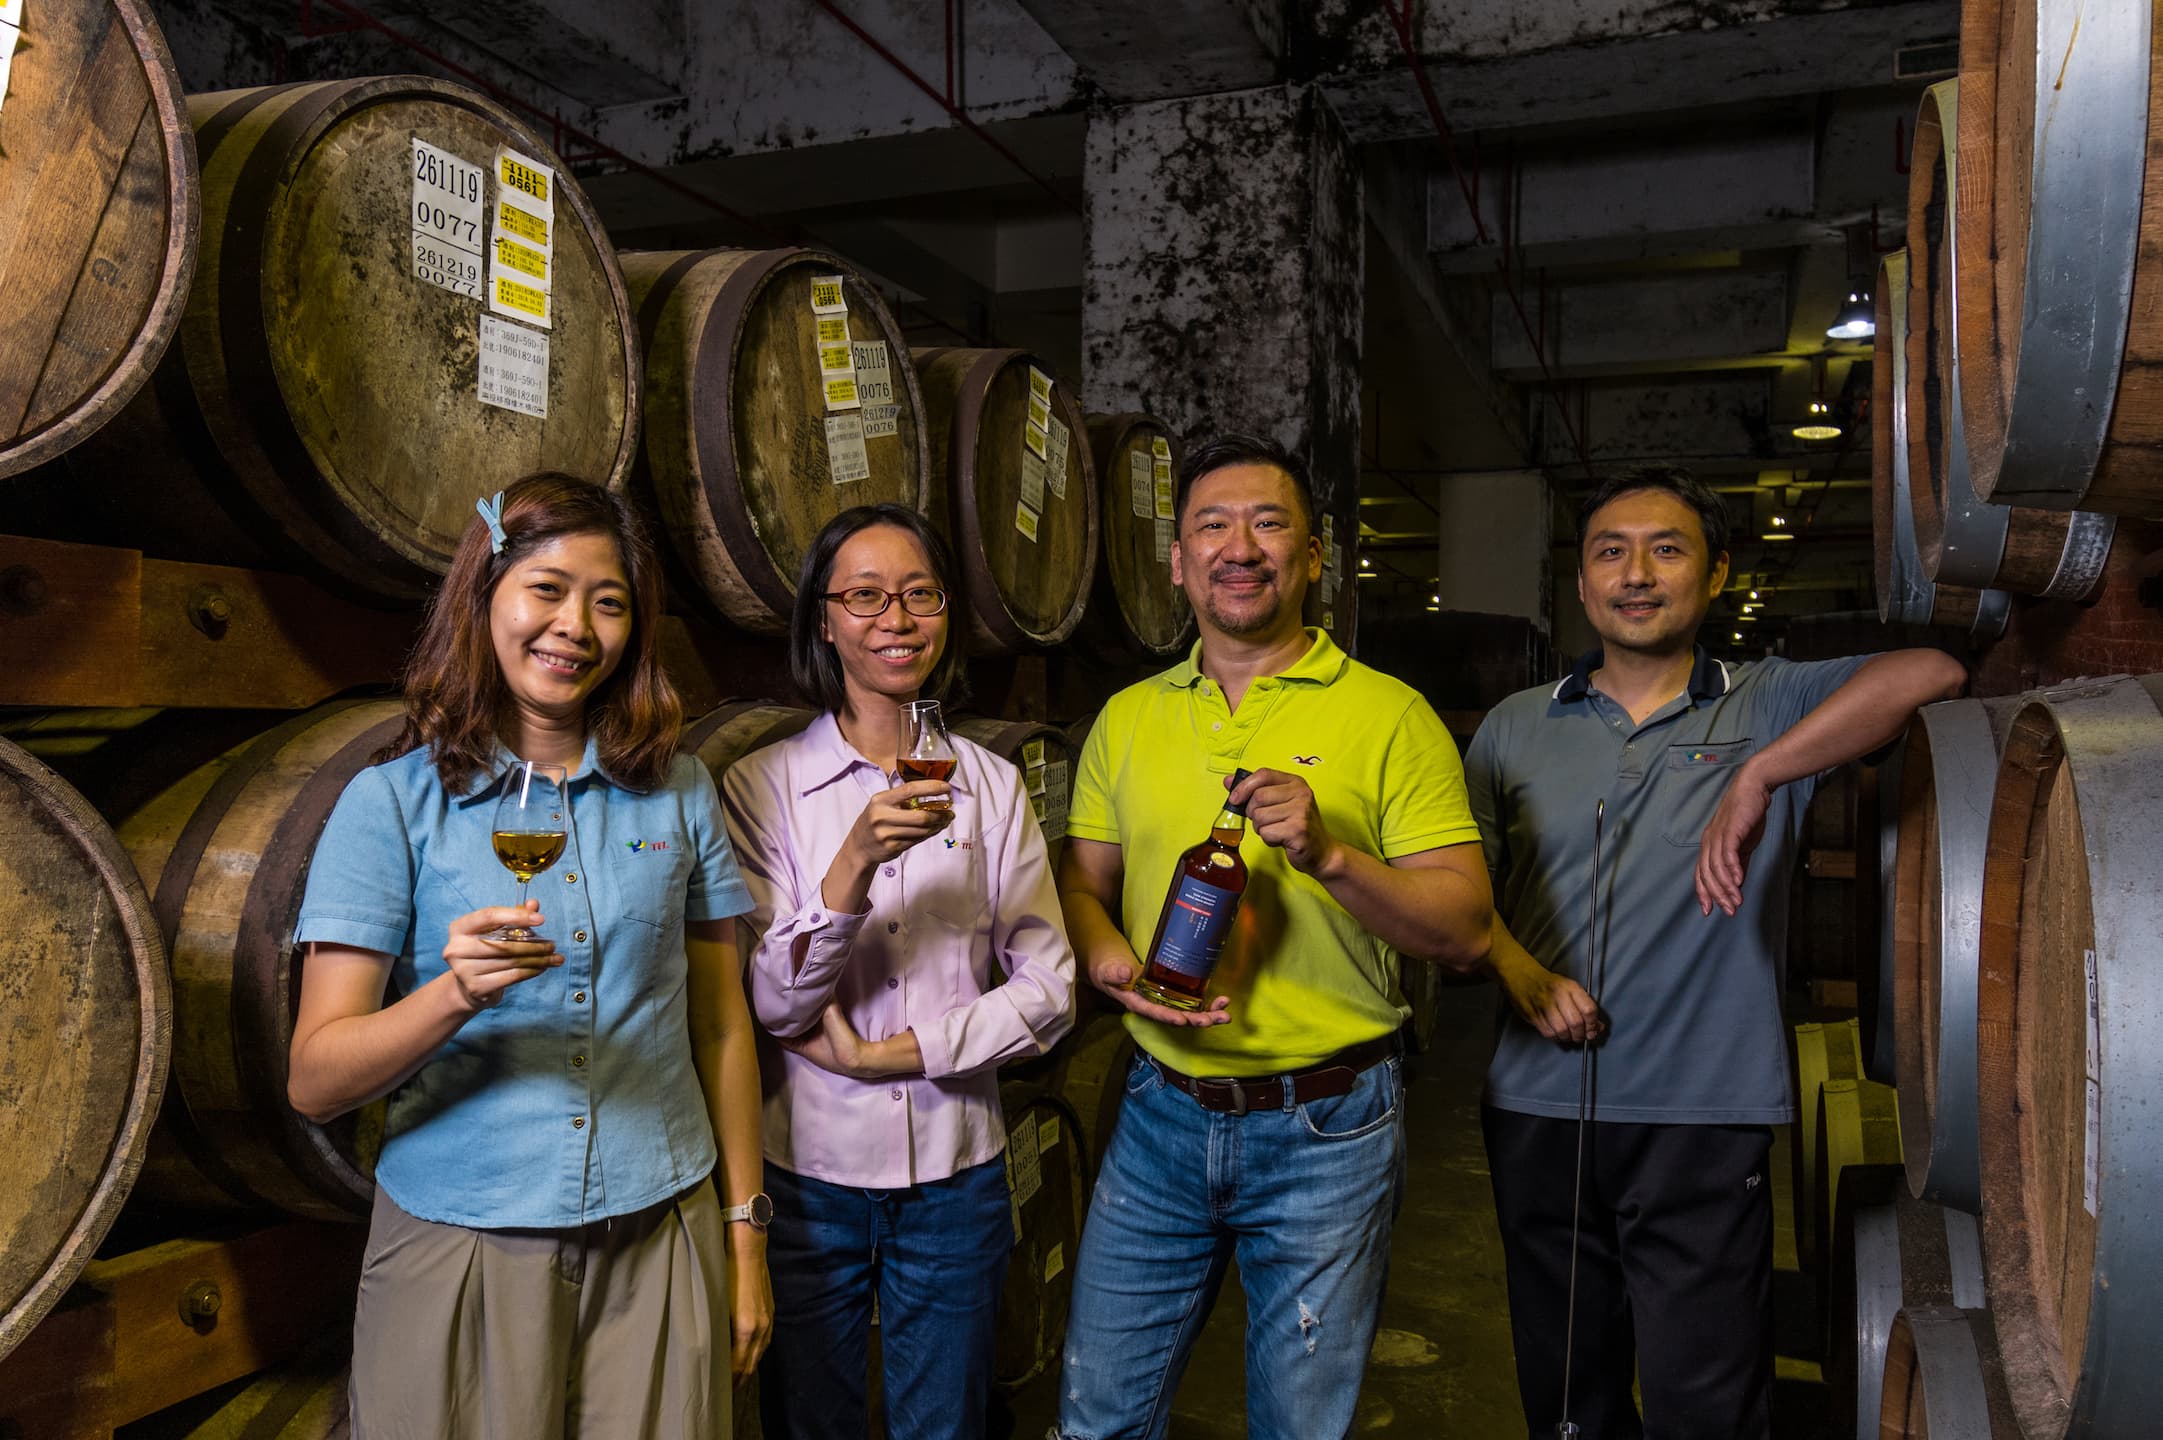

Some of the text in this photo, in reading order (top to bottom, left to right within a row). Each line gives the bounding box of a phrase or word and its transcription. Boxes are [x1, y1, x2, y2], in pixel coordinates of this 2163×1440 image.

[416, 149, 478, 203] 261119
[509, 163, 538, 185] 1111
[509, 174, 538, 196] 0561
[417, 201, 477, 242] 0077
[417, 245, 477, 281] 261219
[418, 265, 476, 296] 0077
[854, 346, 886, 370] 261119
[860, 382, 890, 400] 0076
[863, 407, 897, 421] 261219
[866, 421, 894, 434] 0076
